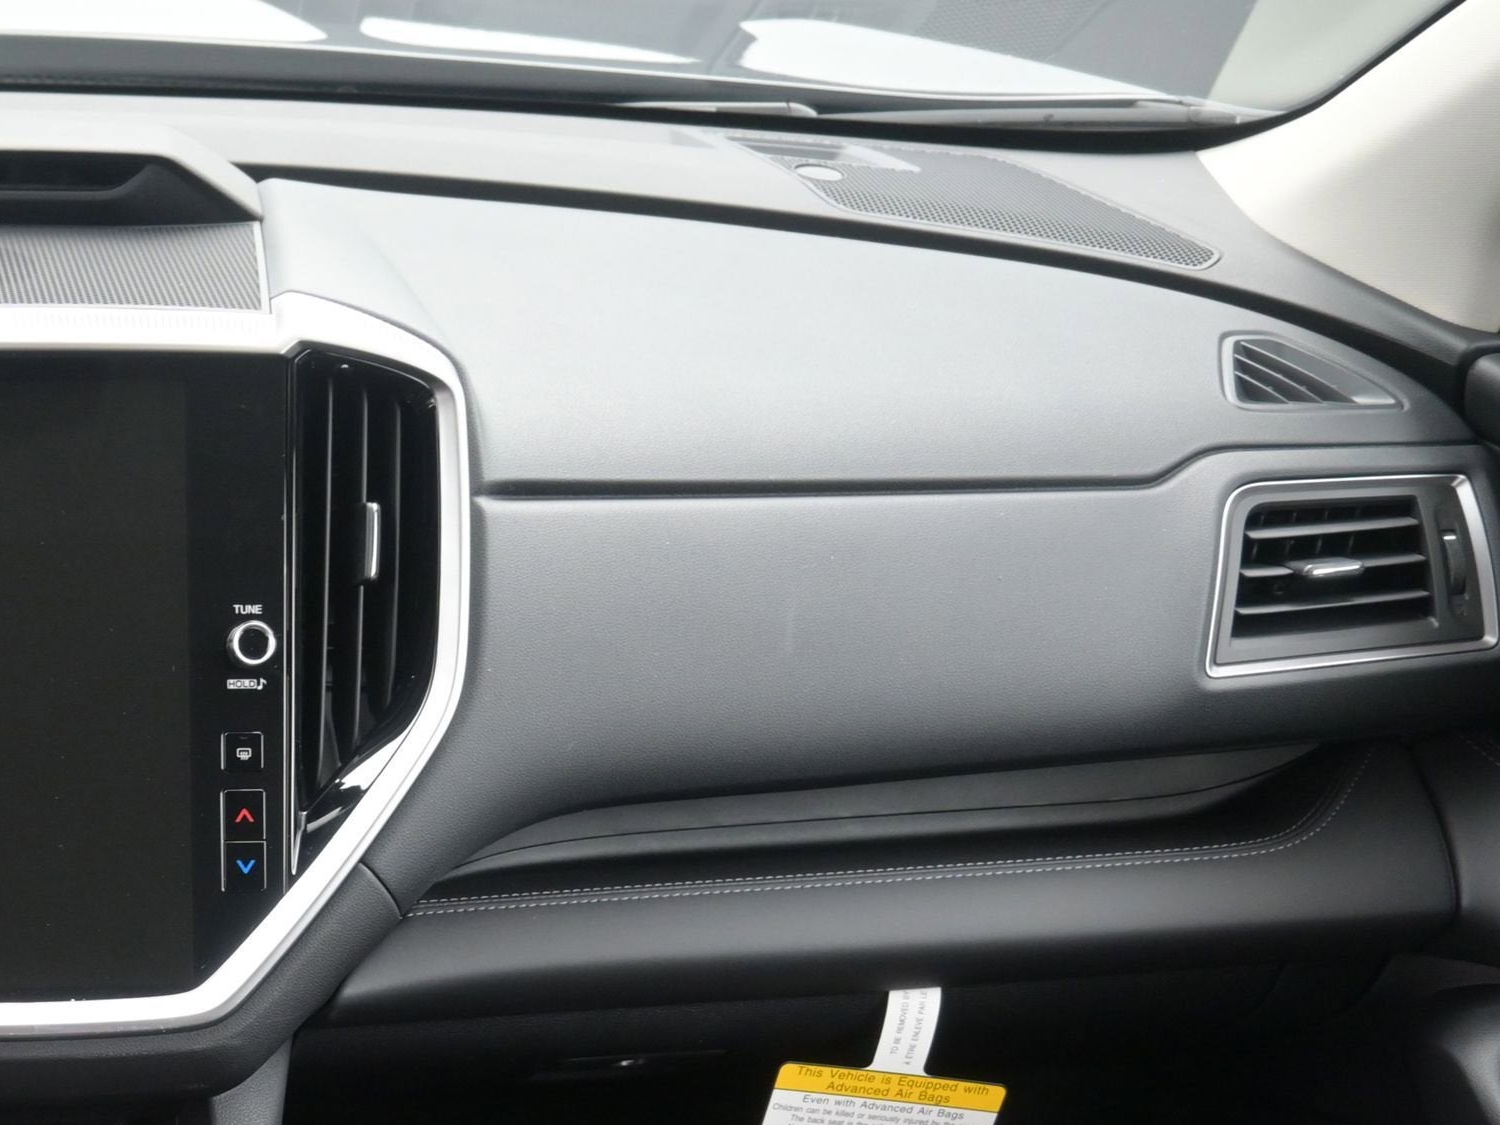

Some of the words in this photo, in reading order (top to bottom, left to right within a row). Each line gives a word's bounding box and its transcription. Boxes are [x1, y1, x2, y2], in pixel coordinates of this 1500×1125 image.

[233, 604, 262, 614] TUNE
[228, 679, 257, 689] HOLD
[797, 1065, 823, 1078] This
[830, 1069, 876, 1083] Vehicle
[881, 1075, 891, 1085] is
[897, 1076, 959, 1092] Equipped
[963, 1085, 989, 1096] with
[826, 1081, 889, 1097] Advanced
[894, 1088, 913, 1099] Air
[918, 1091, 950, 1104] Bags
[772, 1102, 804, 1112] Children
[802, 1094, 830, 1105] Even
[834, 1099, 856, 1108] with
[860, 1101, 914, 1114] Advanced
[917, 1107, 933, 1116] Air
[937, 1109, 964, 1120] Bags
[791, 1114, 805, 1122] The
